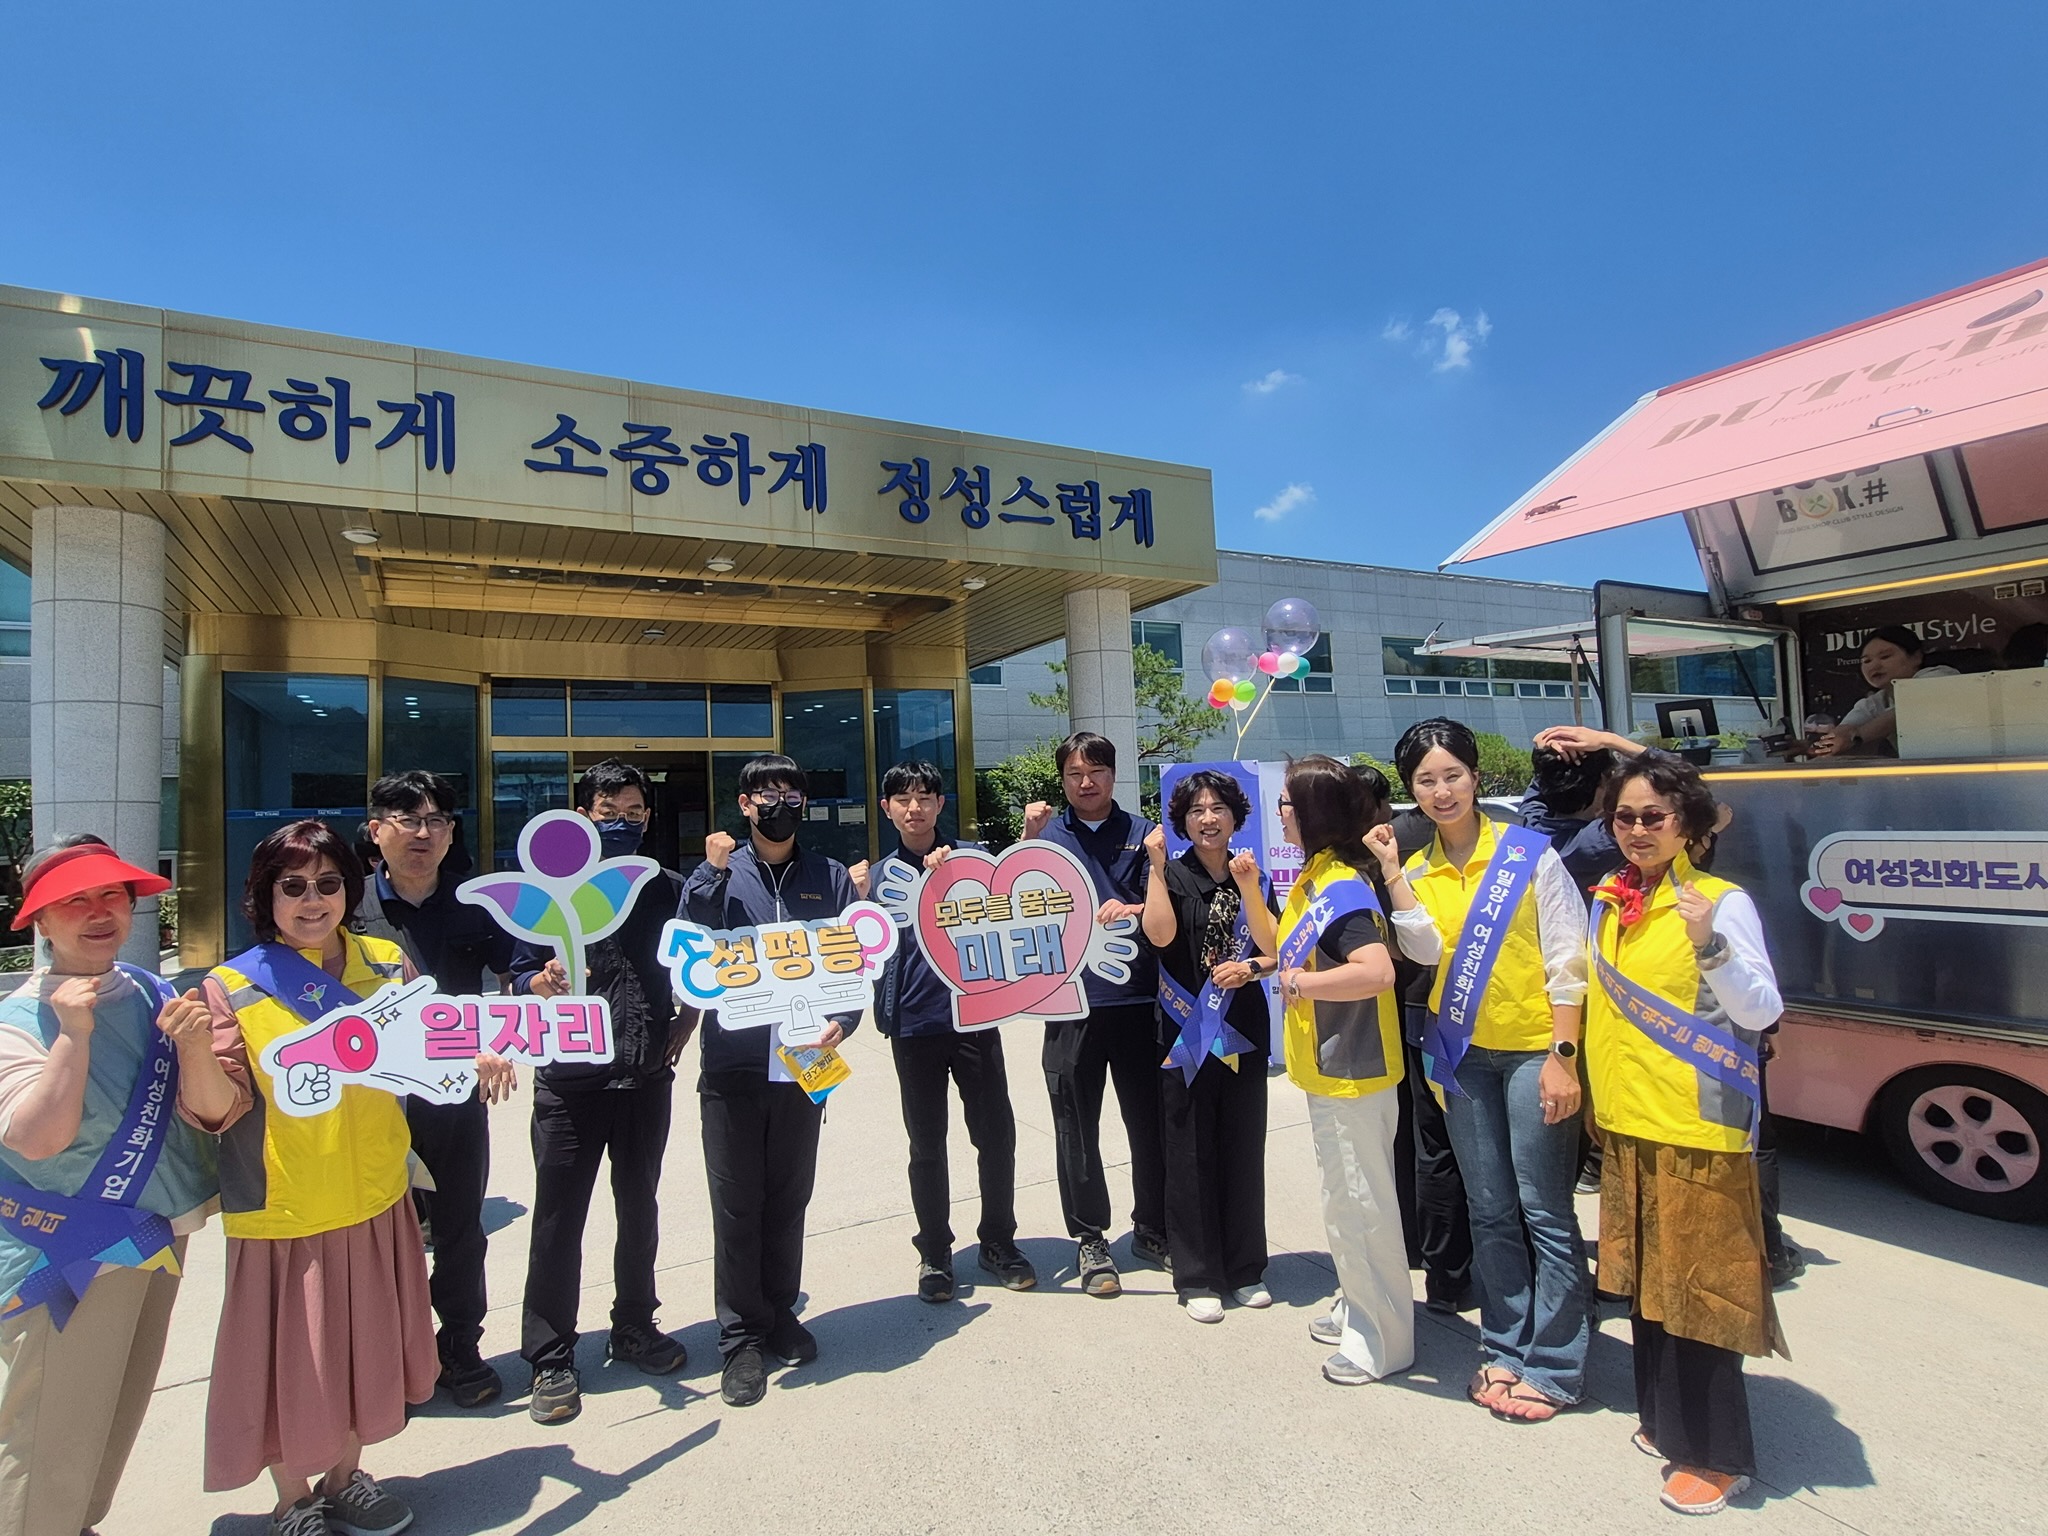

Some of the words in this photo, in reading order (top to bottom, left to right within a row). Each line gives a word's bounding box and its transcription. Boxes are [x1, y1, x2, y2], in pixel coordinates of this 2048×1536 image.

[37, 348, 456, 475] 깨끗하게
[524, 413, 828, 514] 소중하게
[878, 456, 1154, 548] 정성스럽게
[1852, 512, 1874, 521] STYLE
[1875, 506, 1904, 517] DESIGN
[935, 893, 1013, 928] 모두를
[1019, 887, 1075, 919] 품는
[1480, 868, 1516, 921] 밀양시
[707, 923, 866, 989] 성평등
[955, 923, 1069, 982] 미래
[1449, 923, 1493, 1025] 여성친화기업
[419, 1001, 608, 1060] 일자리
[1628, 996, 1693, 1044] 키워가는
[1692, 1033, 1741, 1070] 행복한
[101, 1057, 171, 1200] 여성친화기업
[21, 1206, 67, 1234] 일터
